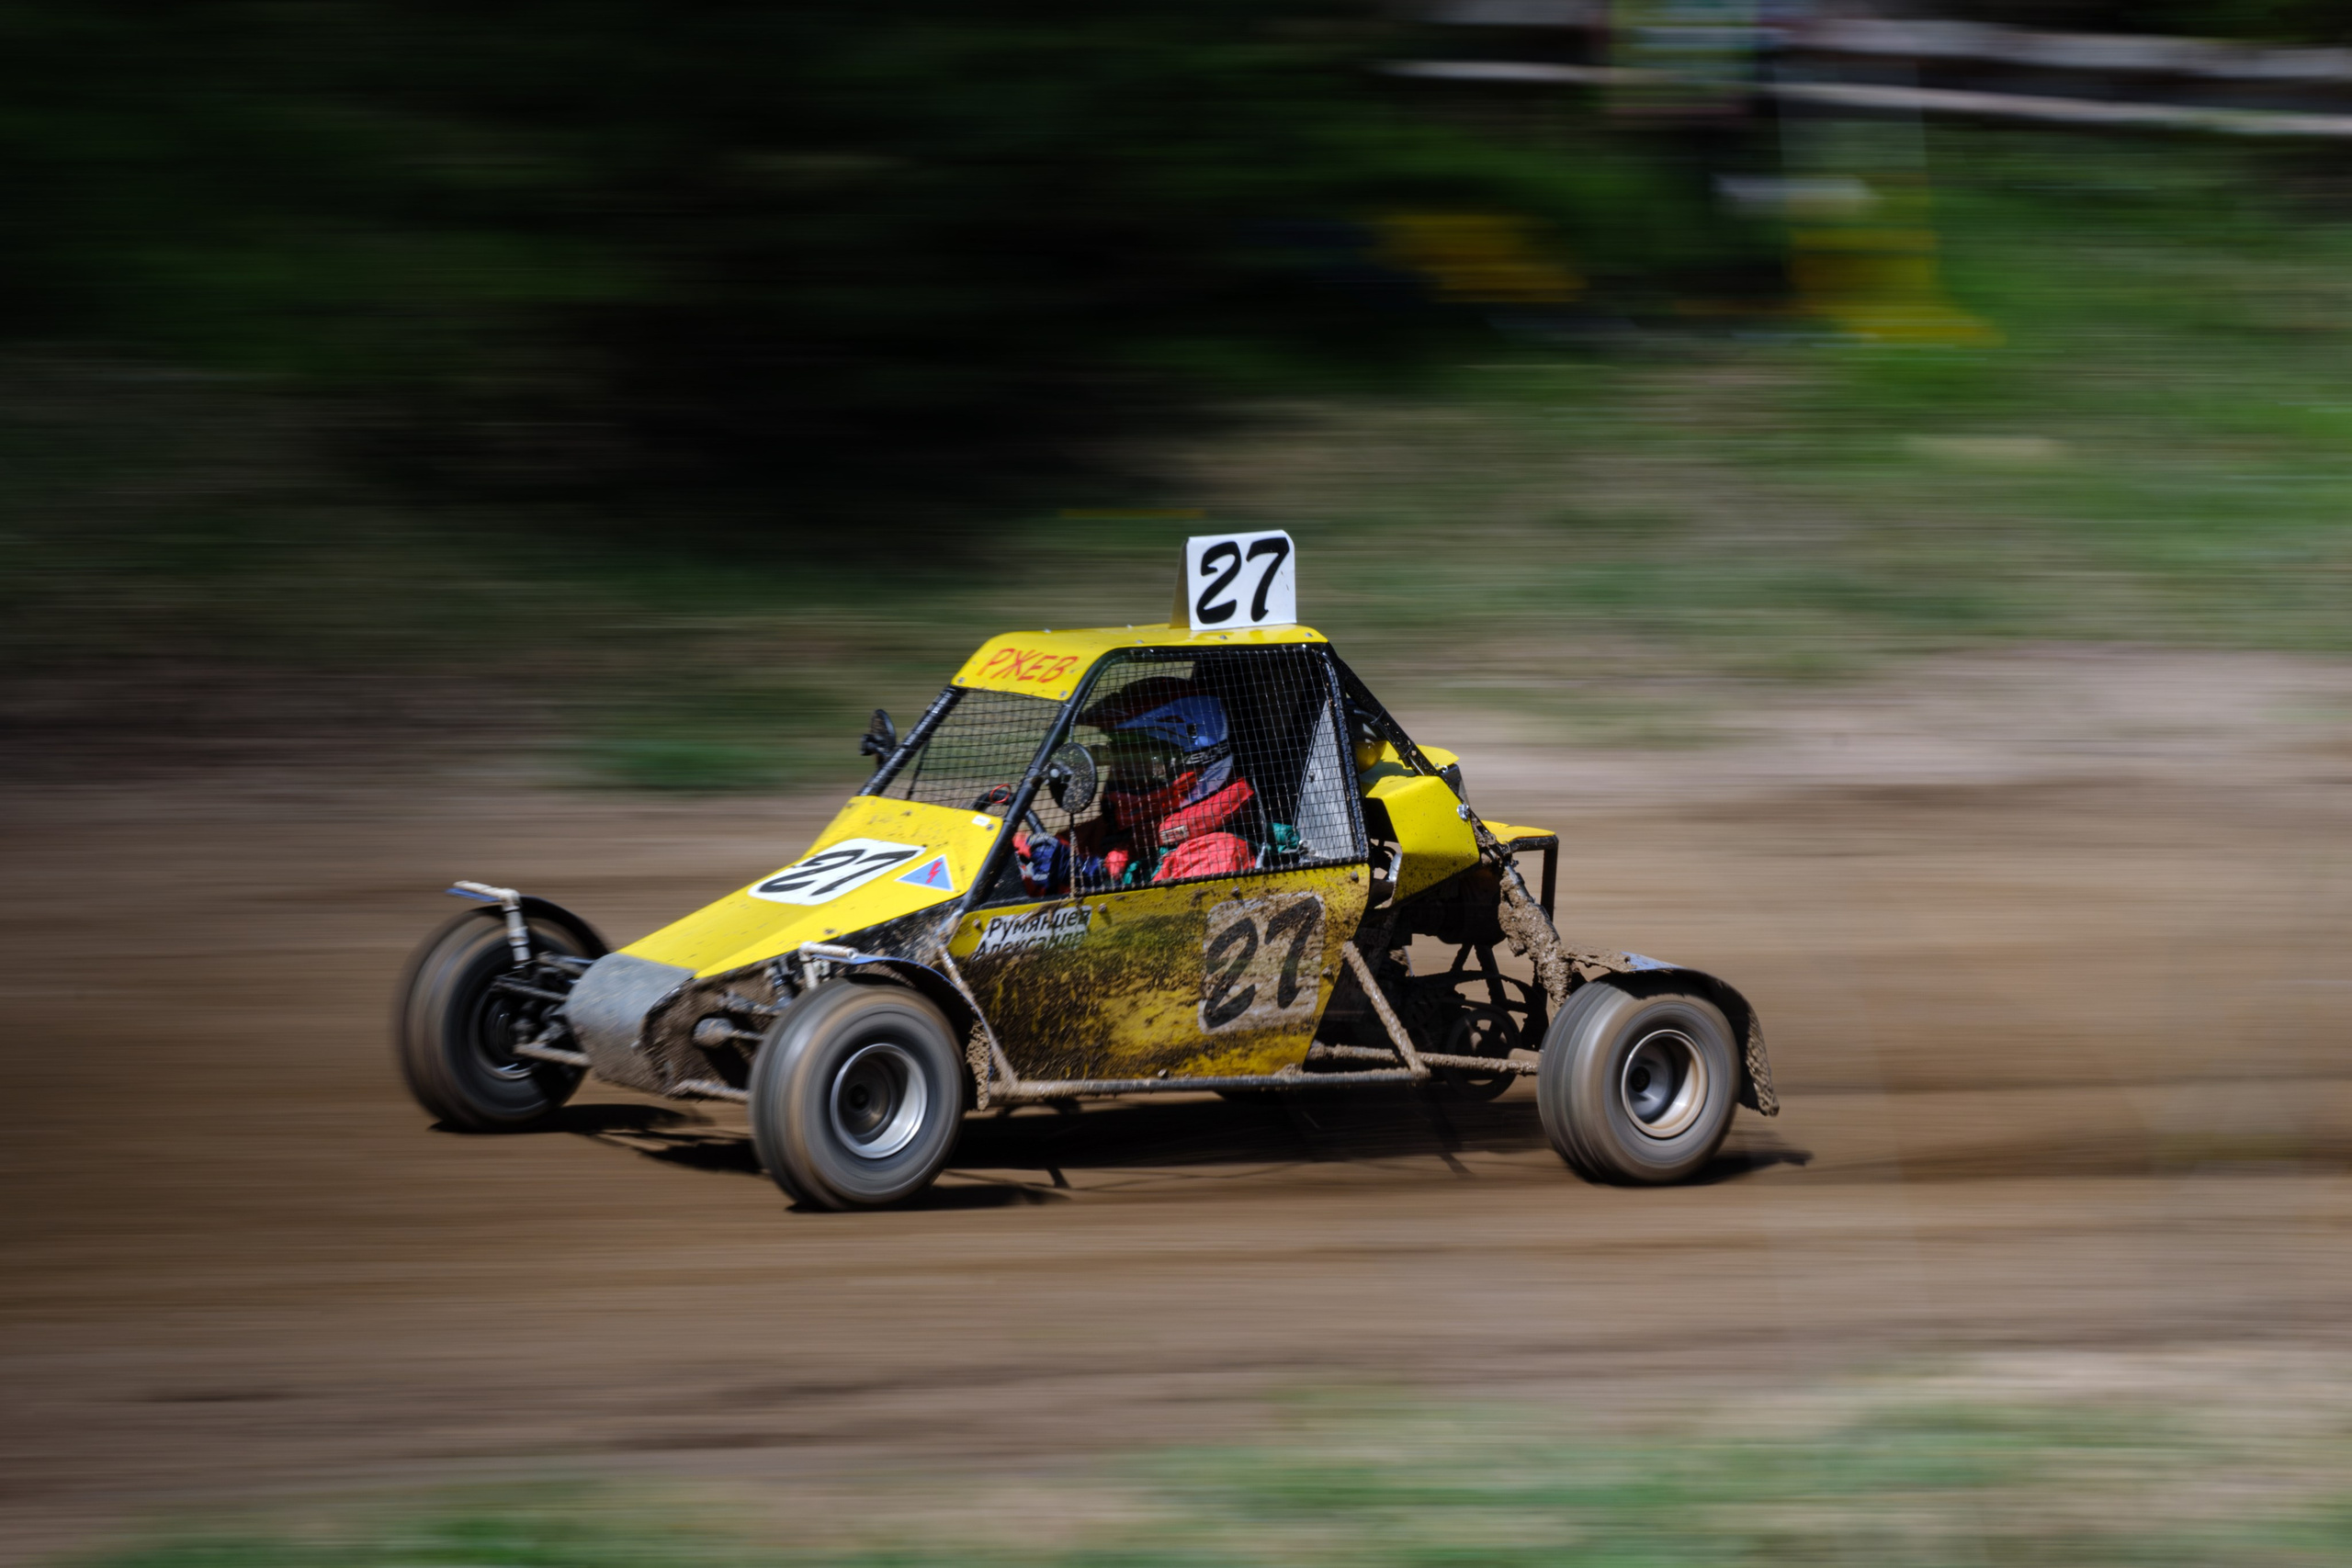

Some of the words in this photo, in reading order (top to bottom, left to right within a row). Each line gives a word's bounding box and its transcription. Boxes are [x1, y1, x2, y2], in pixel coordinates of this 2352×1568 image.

[1196, 536, 1290, 624] 27
[976, 648, 1080, 683] РЖЕВ
[757, 849, 918, 897] 27
[988, 909, 1091, 941] Румянцев
[1204, 897, 1321, 1028] 27
